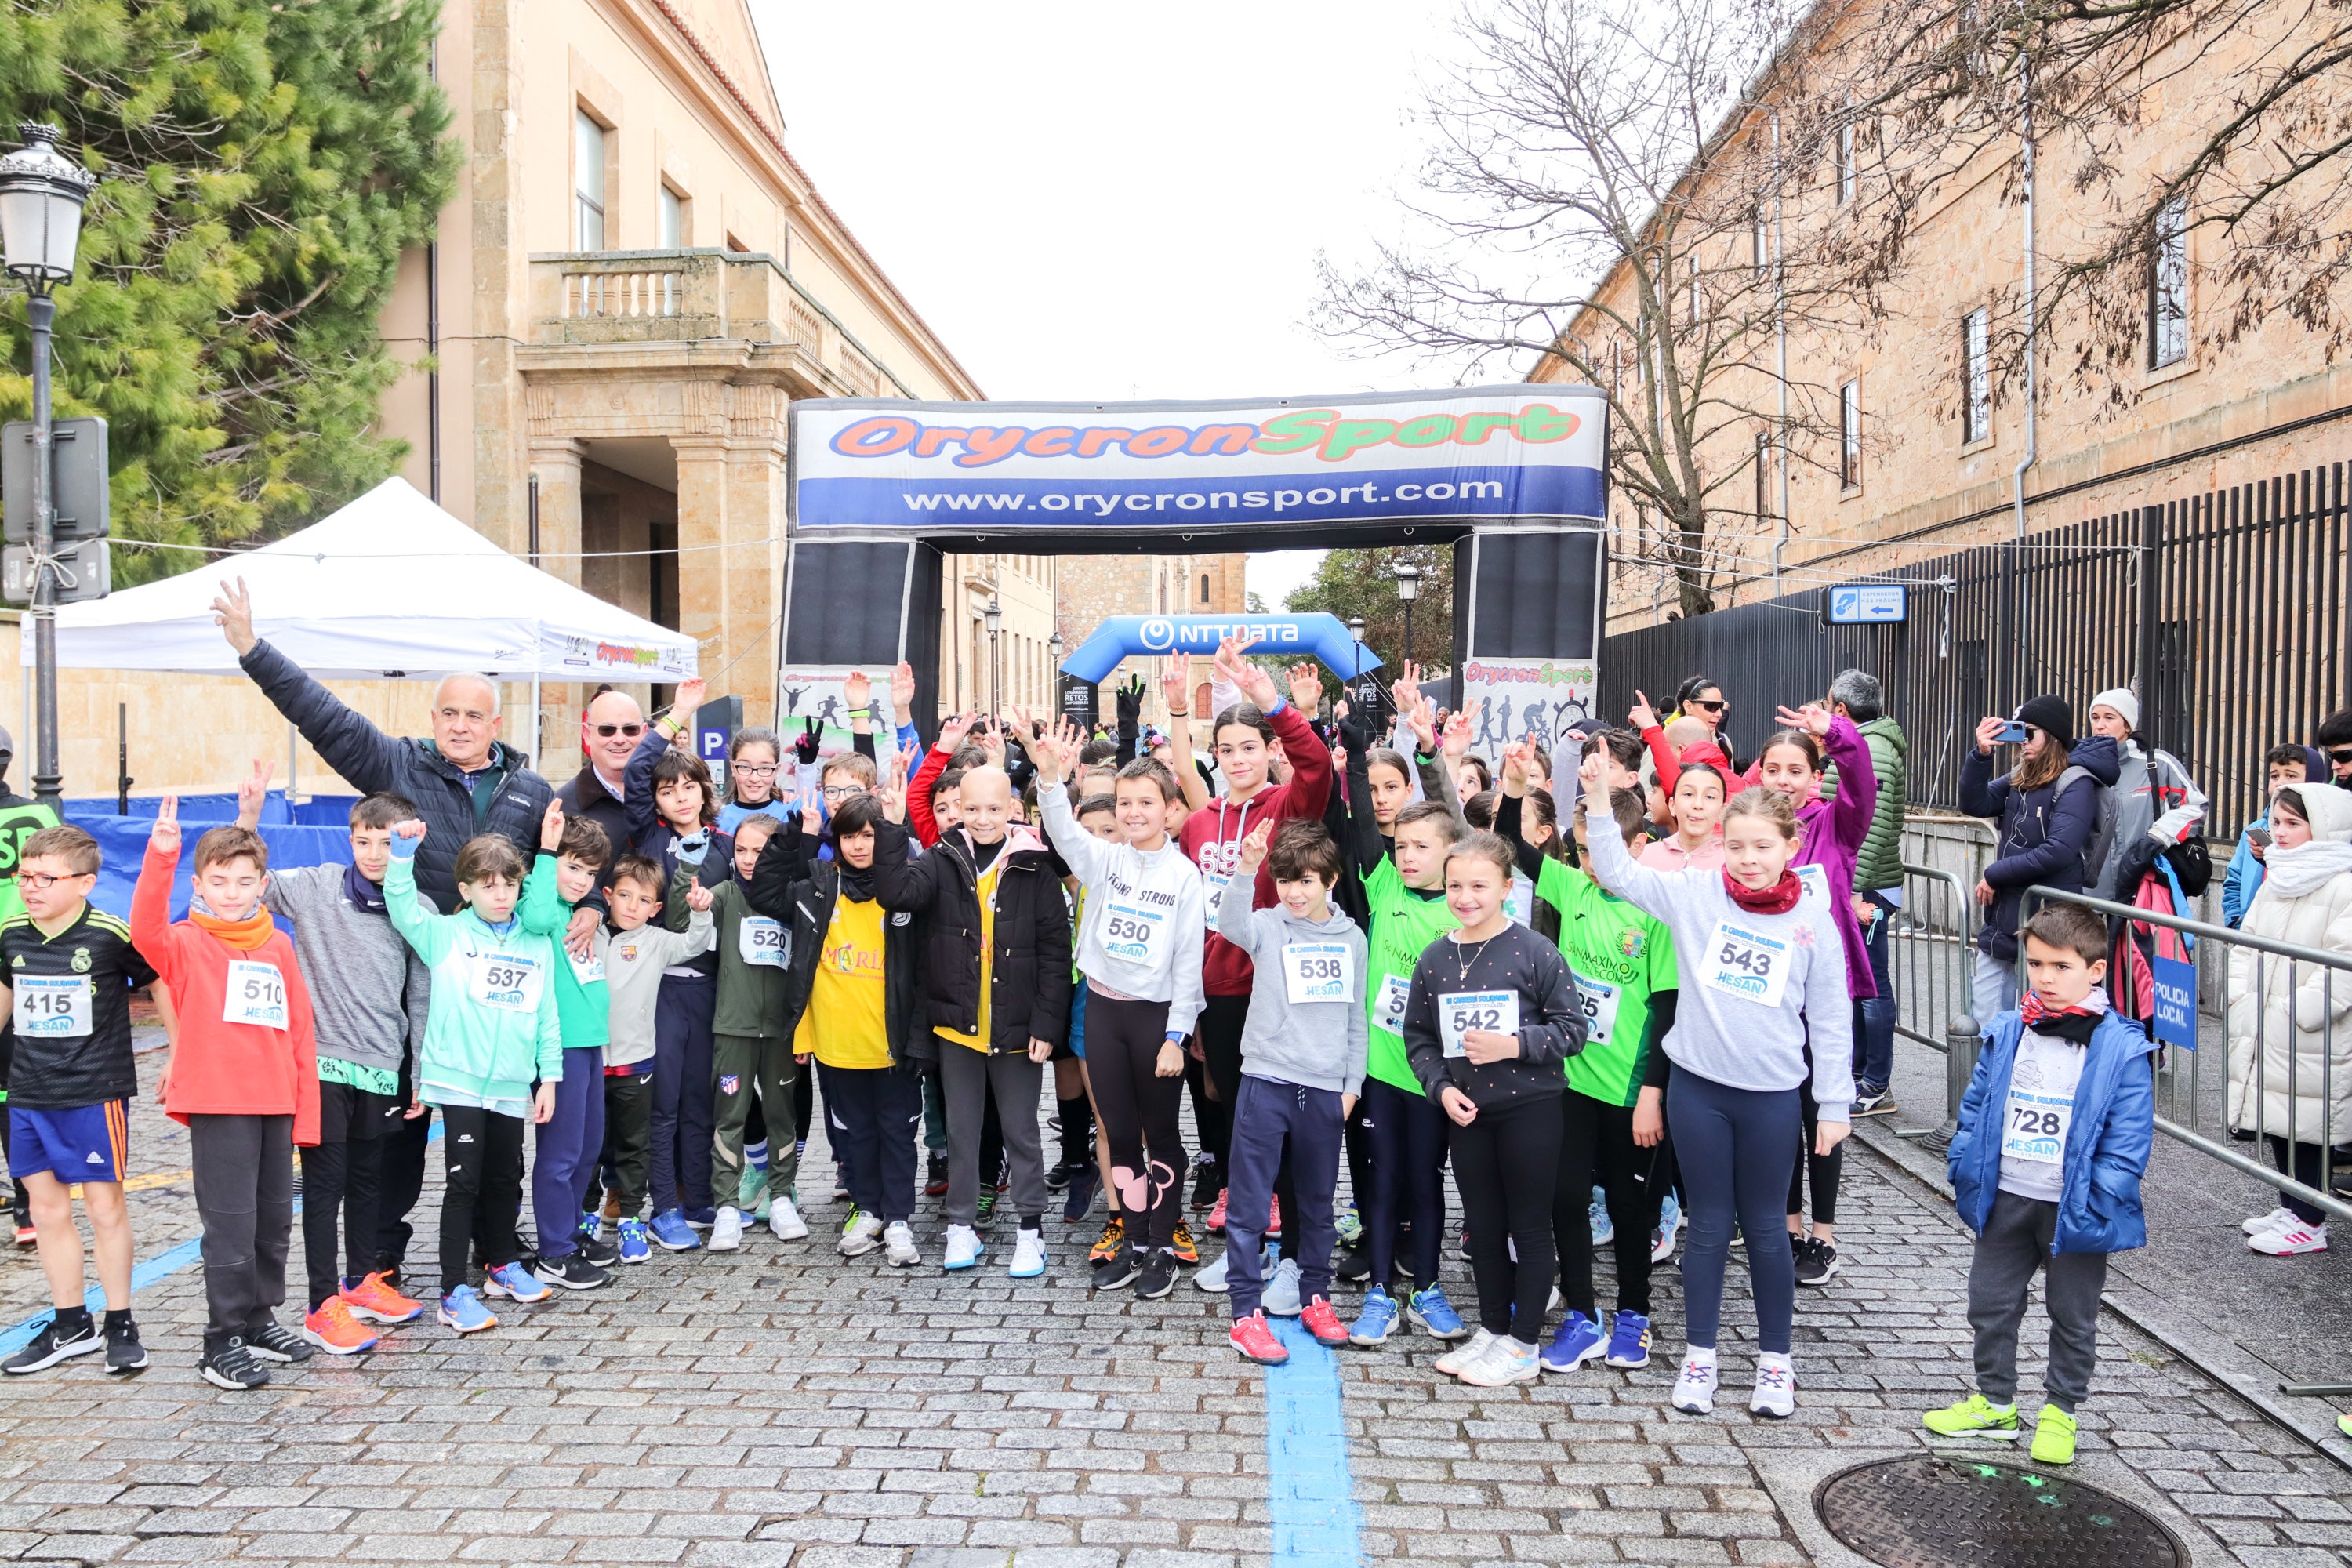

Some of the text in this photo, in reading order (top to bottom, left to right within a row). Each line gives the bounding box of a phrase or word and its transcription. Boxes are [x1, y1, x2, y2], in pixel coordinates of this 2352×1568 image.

[829, 403, 1581, 468] OrycronSport
[903, 478, 1503, 516] www.orycronsport.com
[1180, 624, 1229, 643] NTT
[597, 641, 659, 668] OrycronSport
[1466, 662, 1593, 688] OrycronSport
[705, 732, 723, 756] P
[1113, 905, 1136, 915] CARRERA
[1138, 910, 1163, 921] SOLIDARIA
[753, 930, 786, 949] 520
[1108, 917, 1151, 942] 530
[1728, 927, 1754, 941] CARRERA
[1755, 936, 1785, 951] SOLIDARIA
[753, 951, 783, 963] HESAN
[1104, 942, 1144, 958] HESAN
[1566, 941, 1630, 975] SANMAXIMO
[1719, 942, 1771, 976] 543
[486, 967, 528, 989] 537
[1300, 959, 1342, 978] 538
[244, 979, 282, 1005] 510
[1305, 985, 1341, 996] HESAN
[1714, 971, 1762, 994] HESAN
[24, 993, 71, 1014] 415
[484, 991, 521, 1004] HESAN
[2155, 982, 2190, 1008] POLICIA
[27, 1020, 69, 1030] HESAN
[242, 1007, 281, 1022] HESAN
[1453, 1009, 1501, 1032] 542
[2157, 1001, 2187, 1028] LOCAL
[2012, 1107, 2060, 1136] 728
[2005, 1138, 2055, 1156] HESAN
